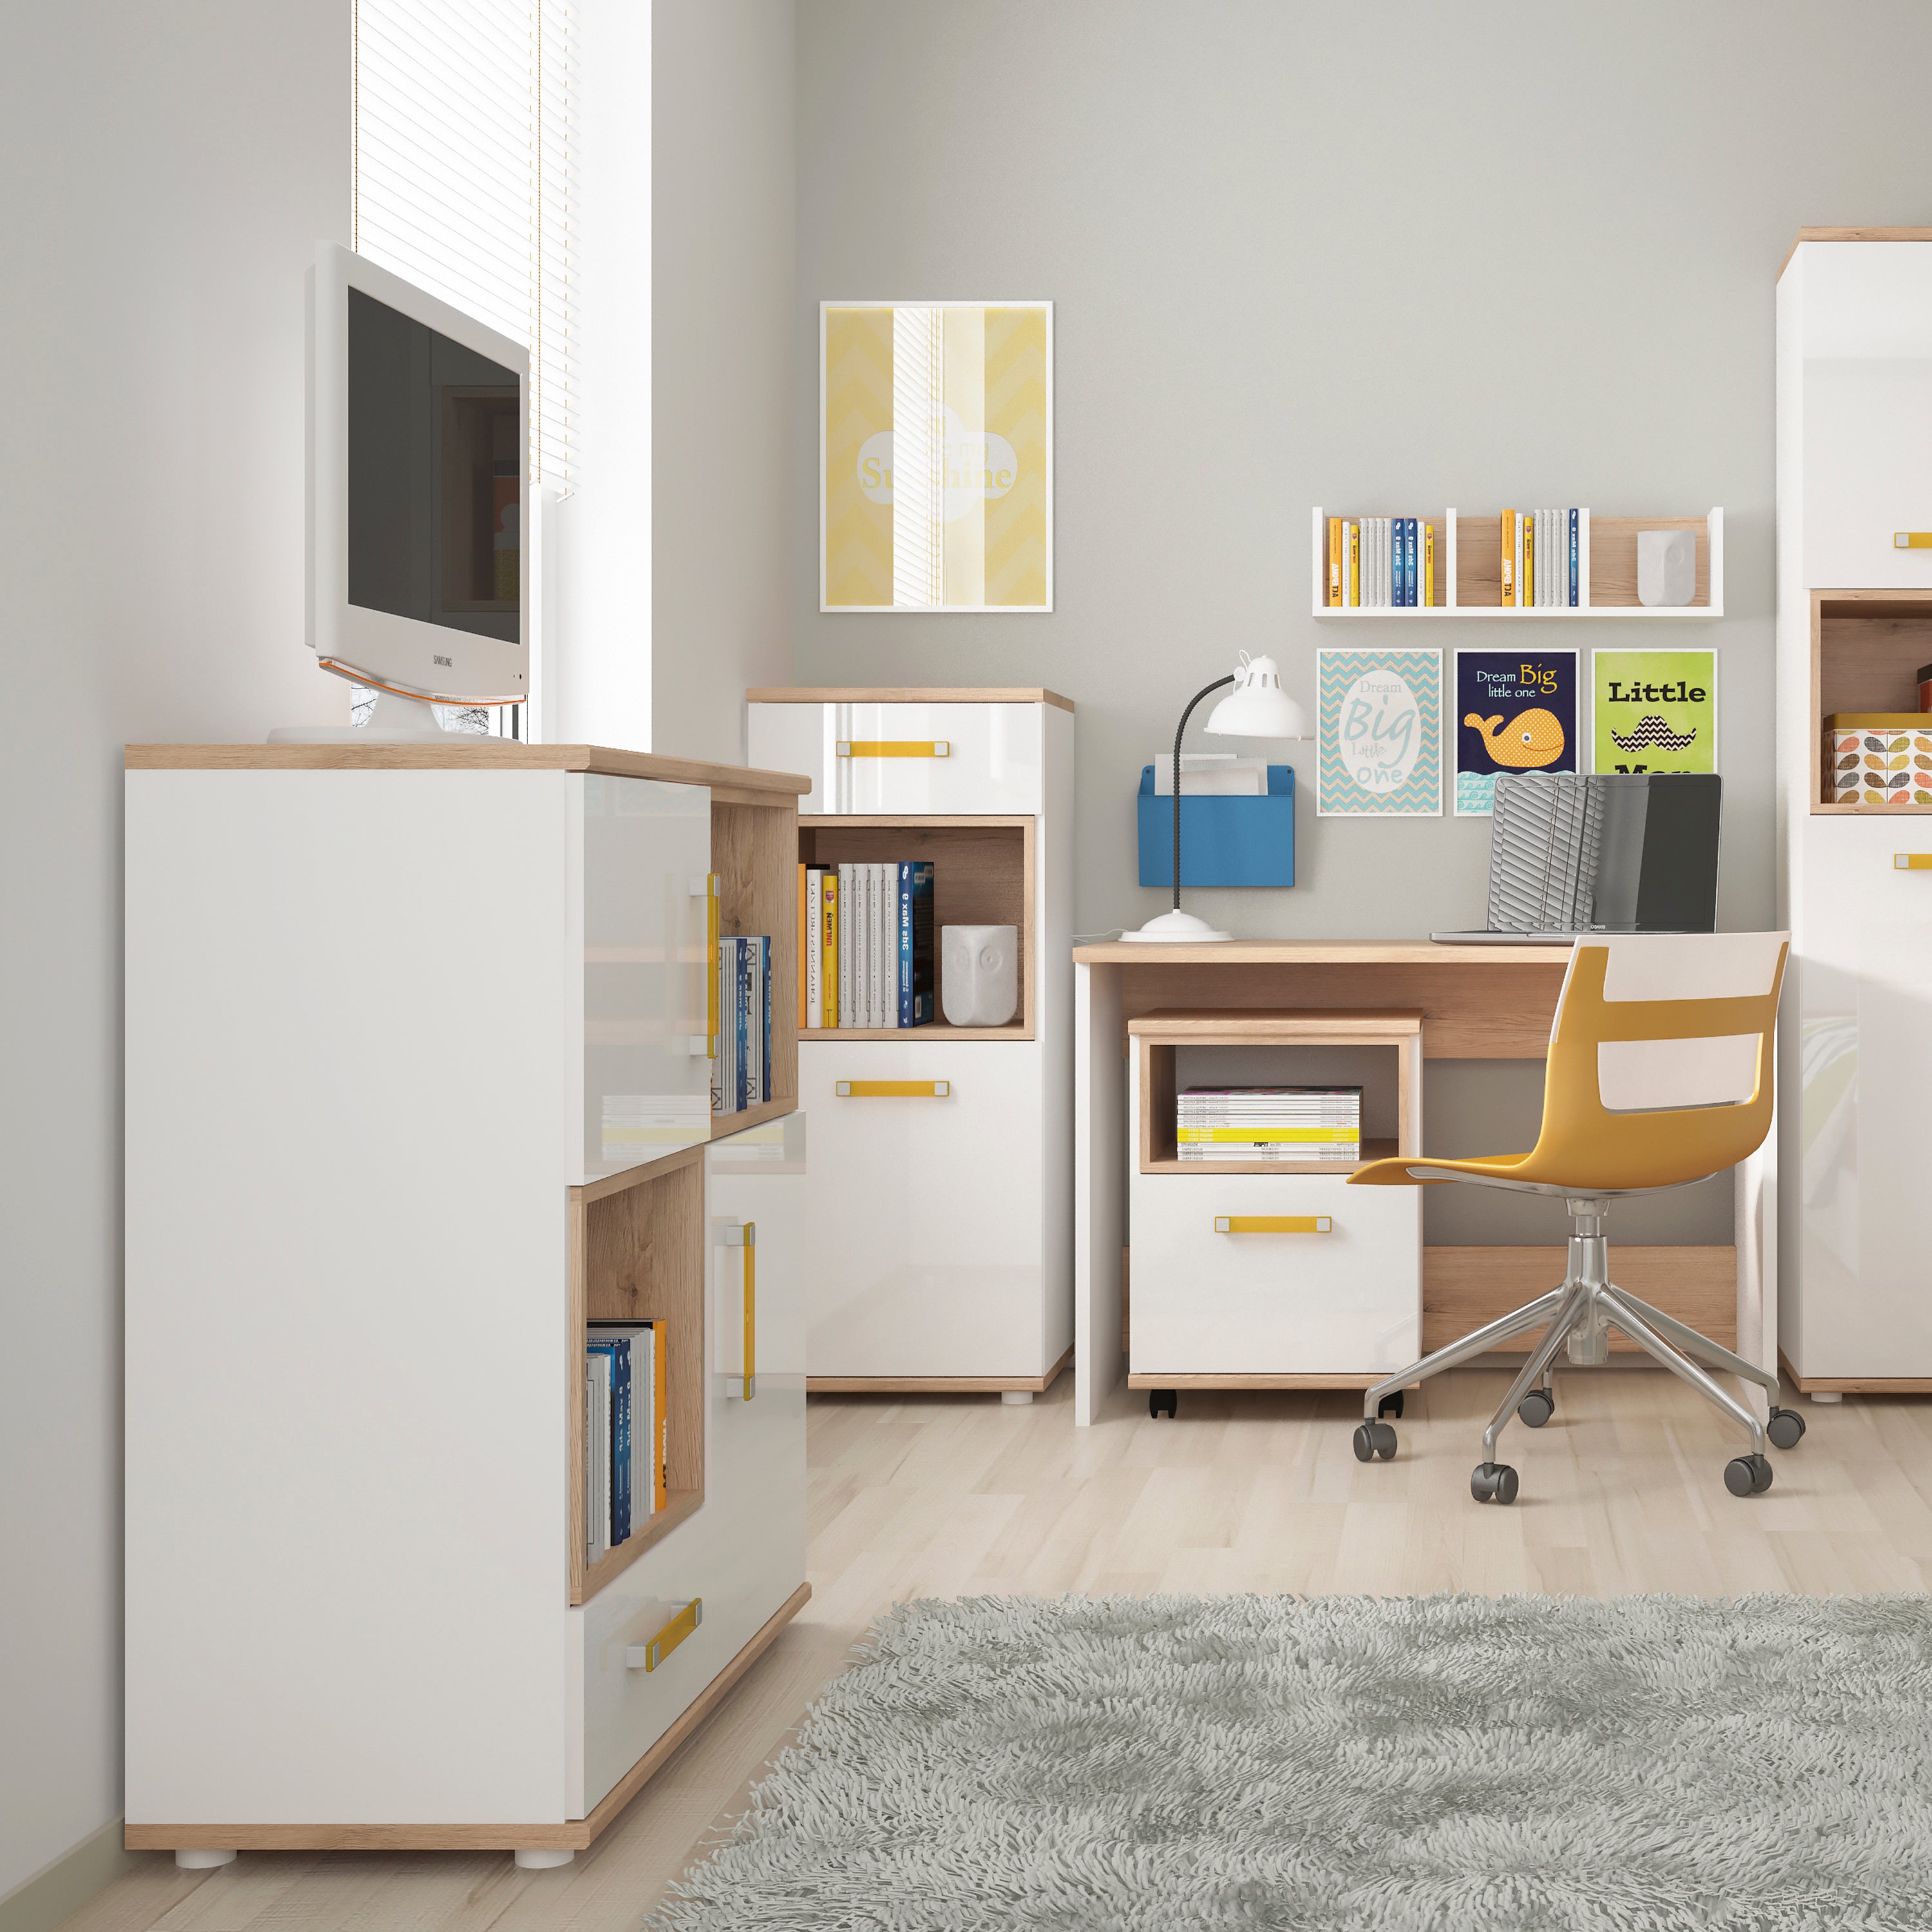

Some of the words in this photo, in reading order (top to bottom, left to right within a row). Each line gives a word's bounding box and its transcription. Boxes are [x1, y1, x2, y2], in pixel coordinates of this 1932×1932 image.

[433, 654, 452, 667] SAMSUNG
[1359, 681, 1402, 693] Dream
[1476, 670, 1516, 683] Dream
[1520, 664, 1558, 694] Big
[1488, 684, 1511, 698] little
[1515, 688, 1536, 698] one
[1608, 681, 1707, 703] Little
[1344, 694, 1416, 769] Big
[1352, 742, 1387, 759] Little
[1356, 766, 1403, 784] one
